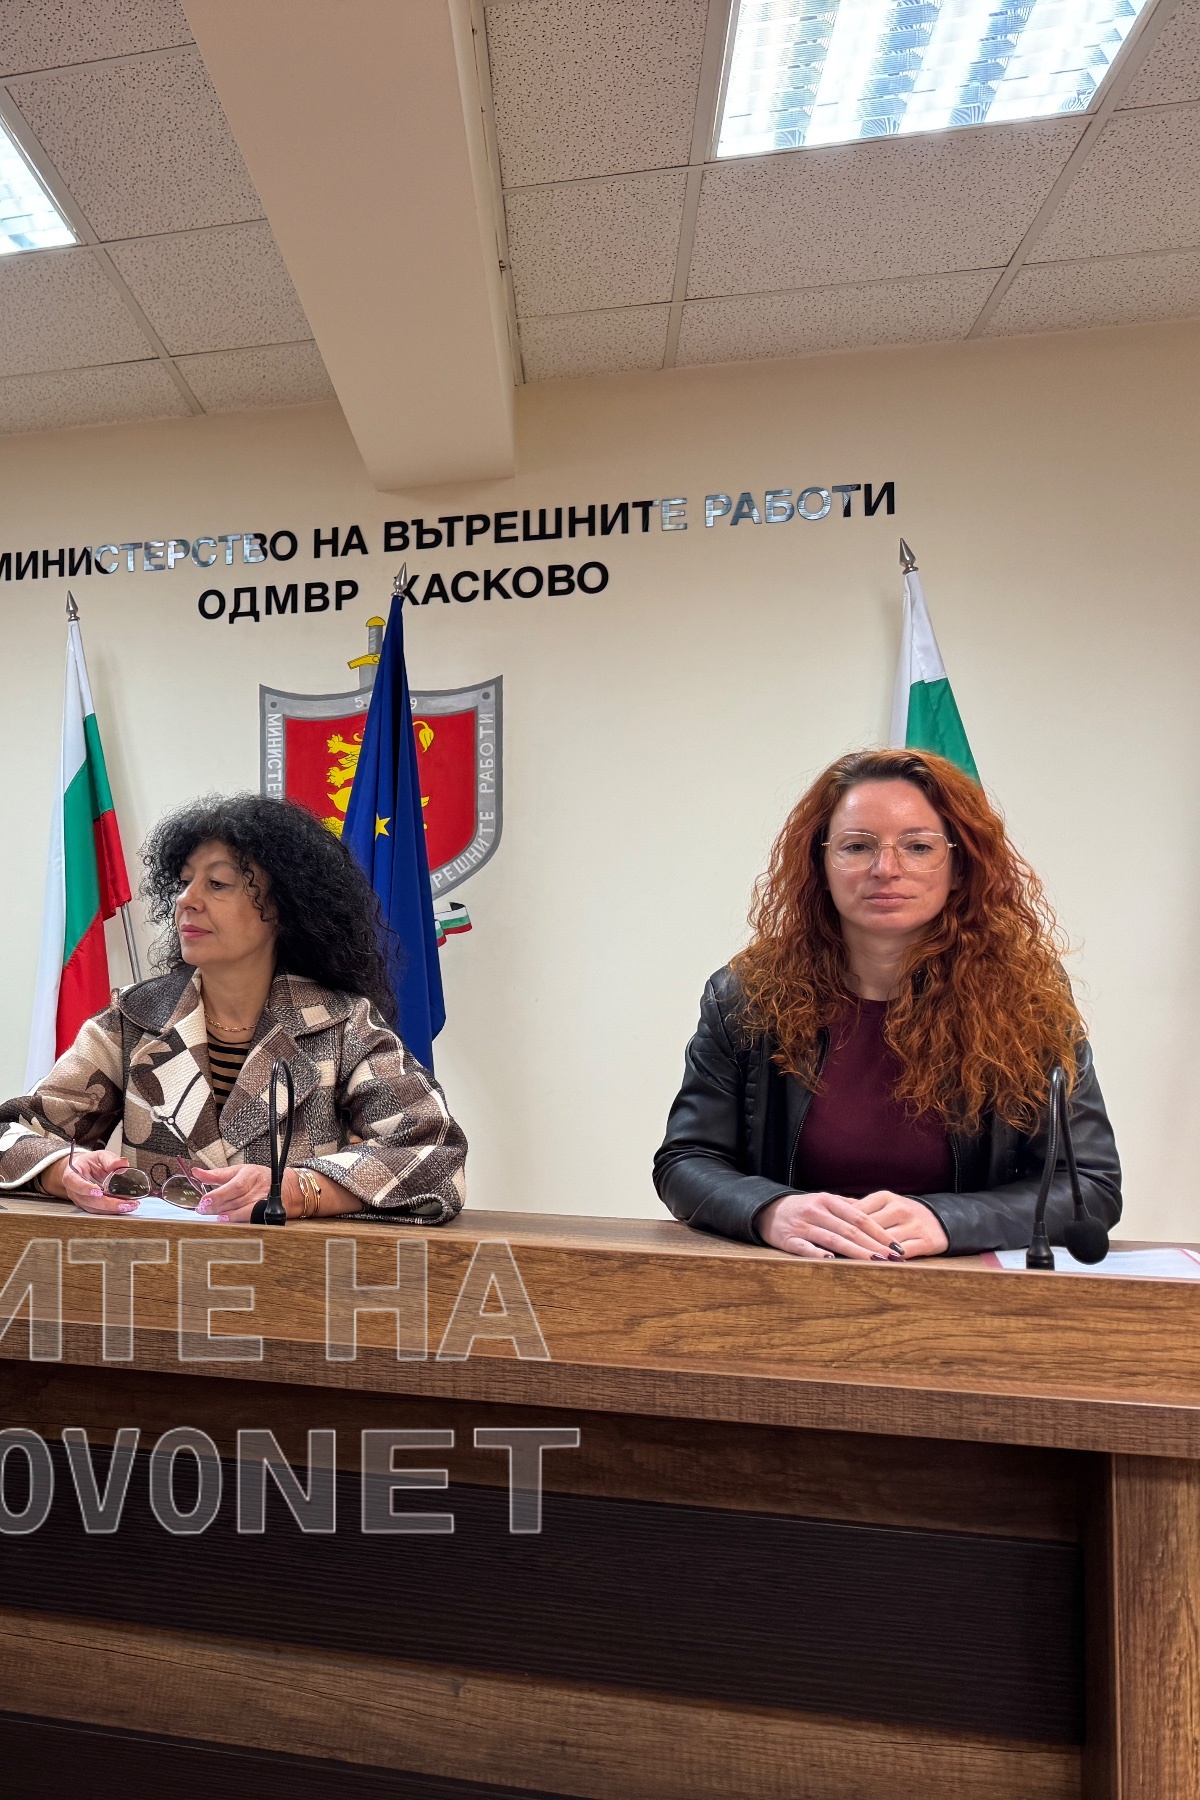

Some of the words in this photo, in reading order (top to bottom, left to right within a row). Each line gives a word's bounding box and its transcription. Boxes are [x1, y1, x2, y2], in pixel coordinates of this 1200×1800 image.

[313, 524, 369, 559] НА
[383, 497, 688, 553] ВЪТРЕШНИТЕ
[704, 481, 895, 528] РАБОТИ
[198, 579, 359, 624] ОДМВР
[431, 811, 494, 889] РЕШНИТЕ
[478, 713, 494, 794] РАБОТИ
